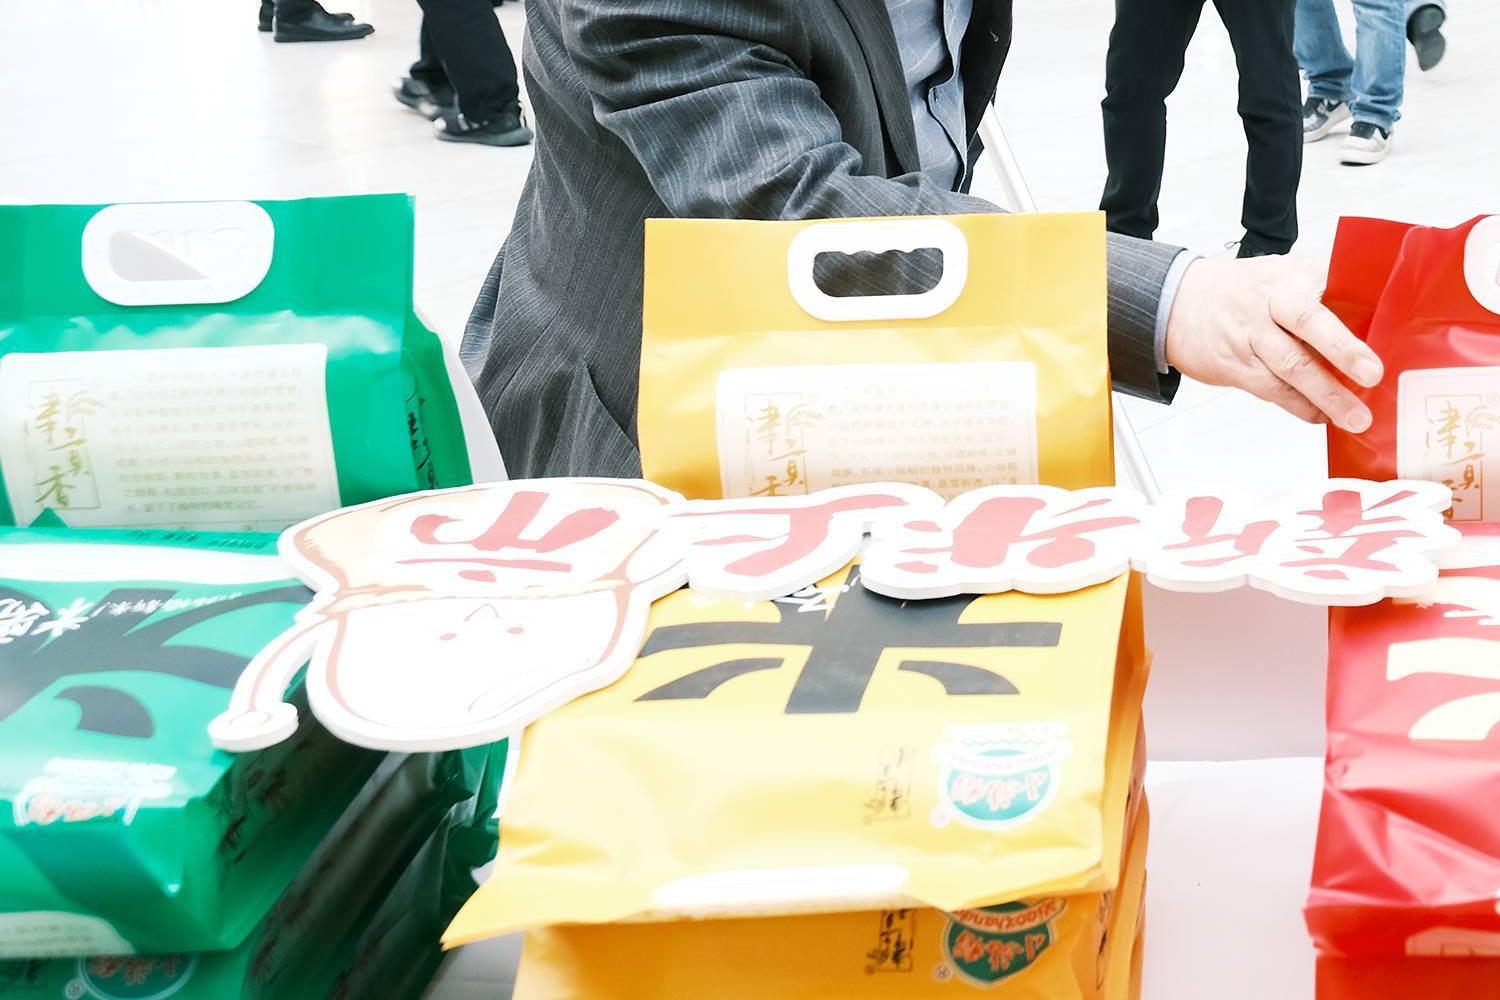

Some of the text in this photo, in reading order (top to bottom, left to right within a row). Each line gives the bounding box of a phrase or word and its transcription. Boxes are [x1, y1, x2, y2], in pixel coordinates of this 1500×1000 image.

[395, 491, 1402, 585] 新米上市
[952, 929, 1047, 972] 小站稻
